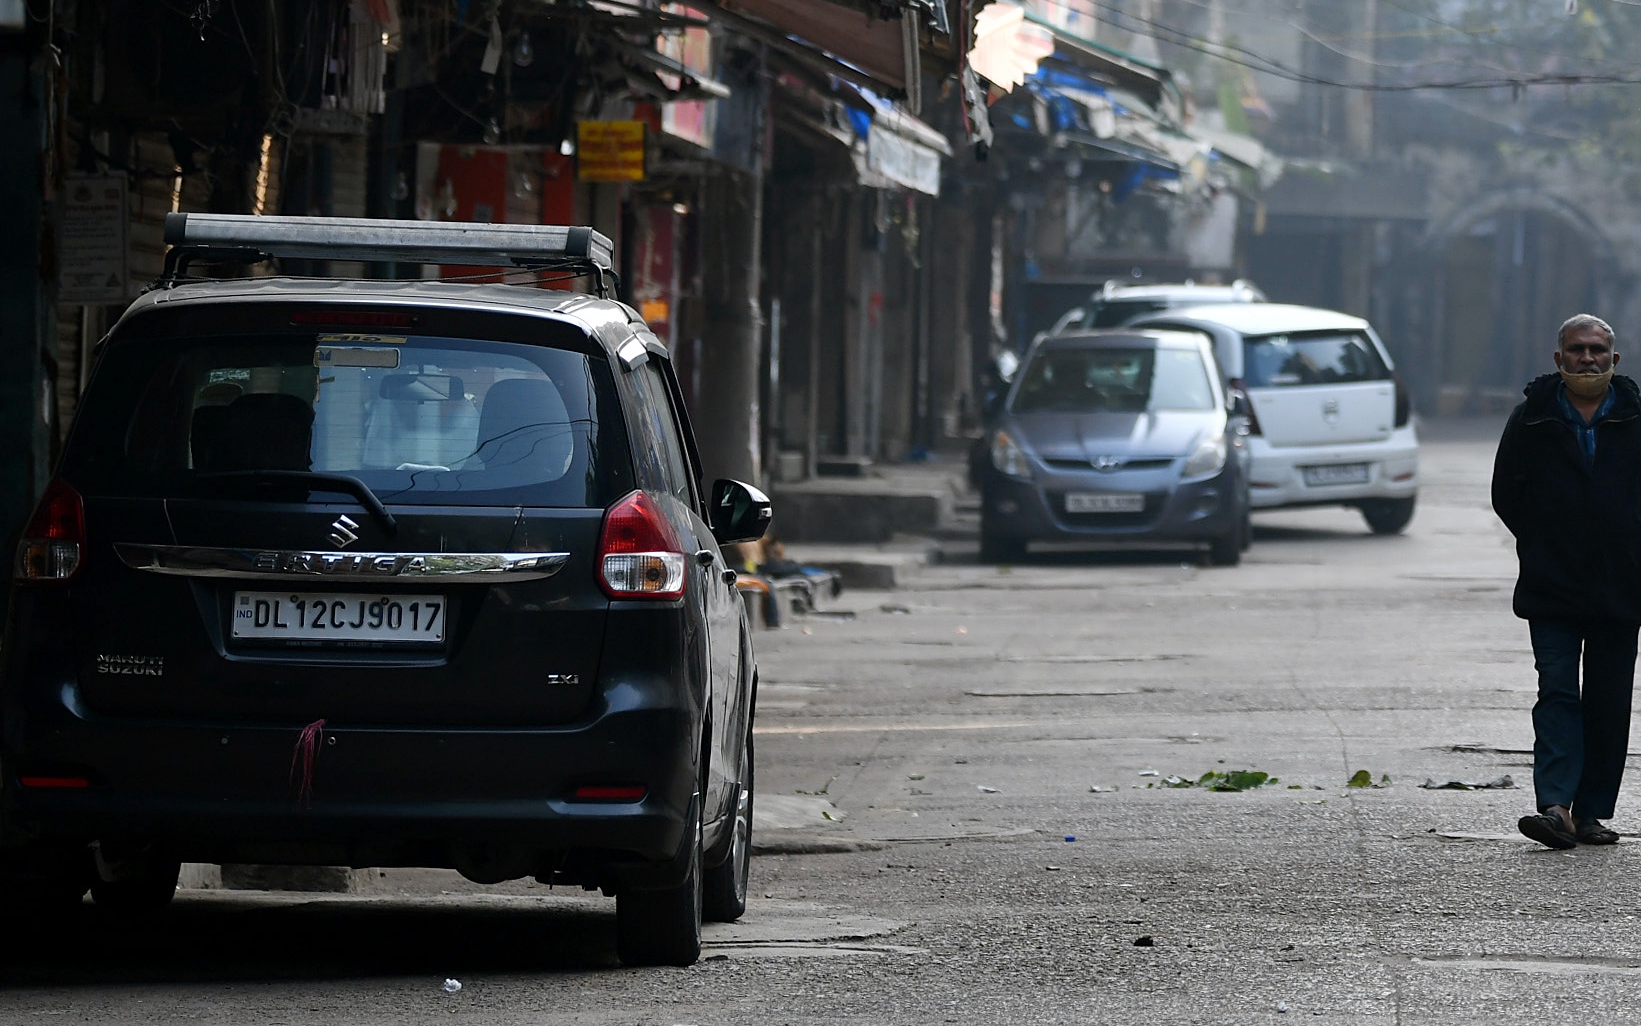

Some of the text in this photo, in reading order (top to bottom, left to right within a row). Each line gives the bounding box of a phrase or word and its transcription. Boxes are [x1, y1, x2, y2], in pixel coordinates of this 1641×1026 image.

[252, 551, 427, 575] ERTIGA
[236, 599, 441, 632] IND DL12CJ9017
[96, 654, 164, 665] MARUTI
[97, 663, 164, 676] SUZUKI
